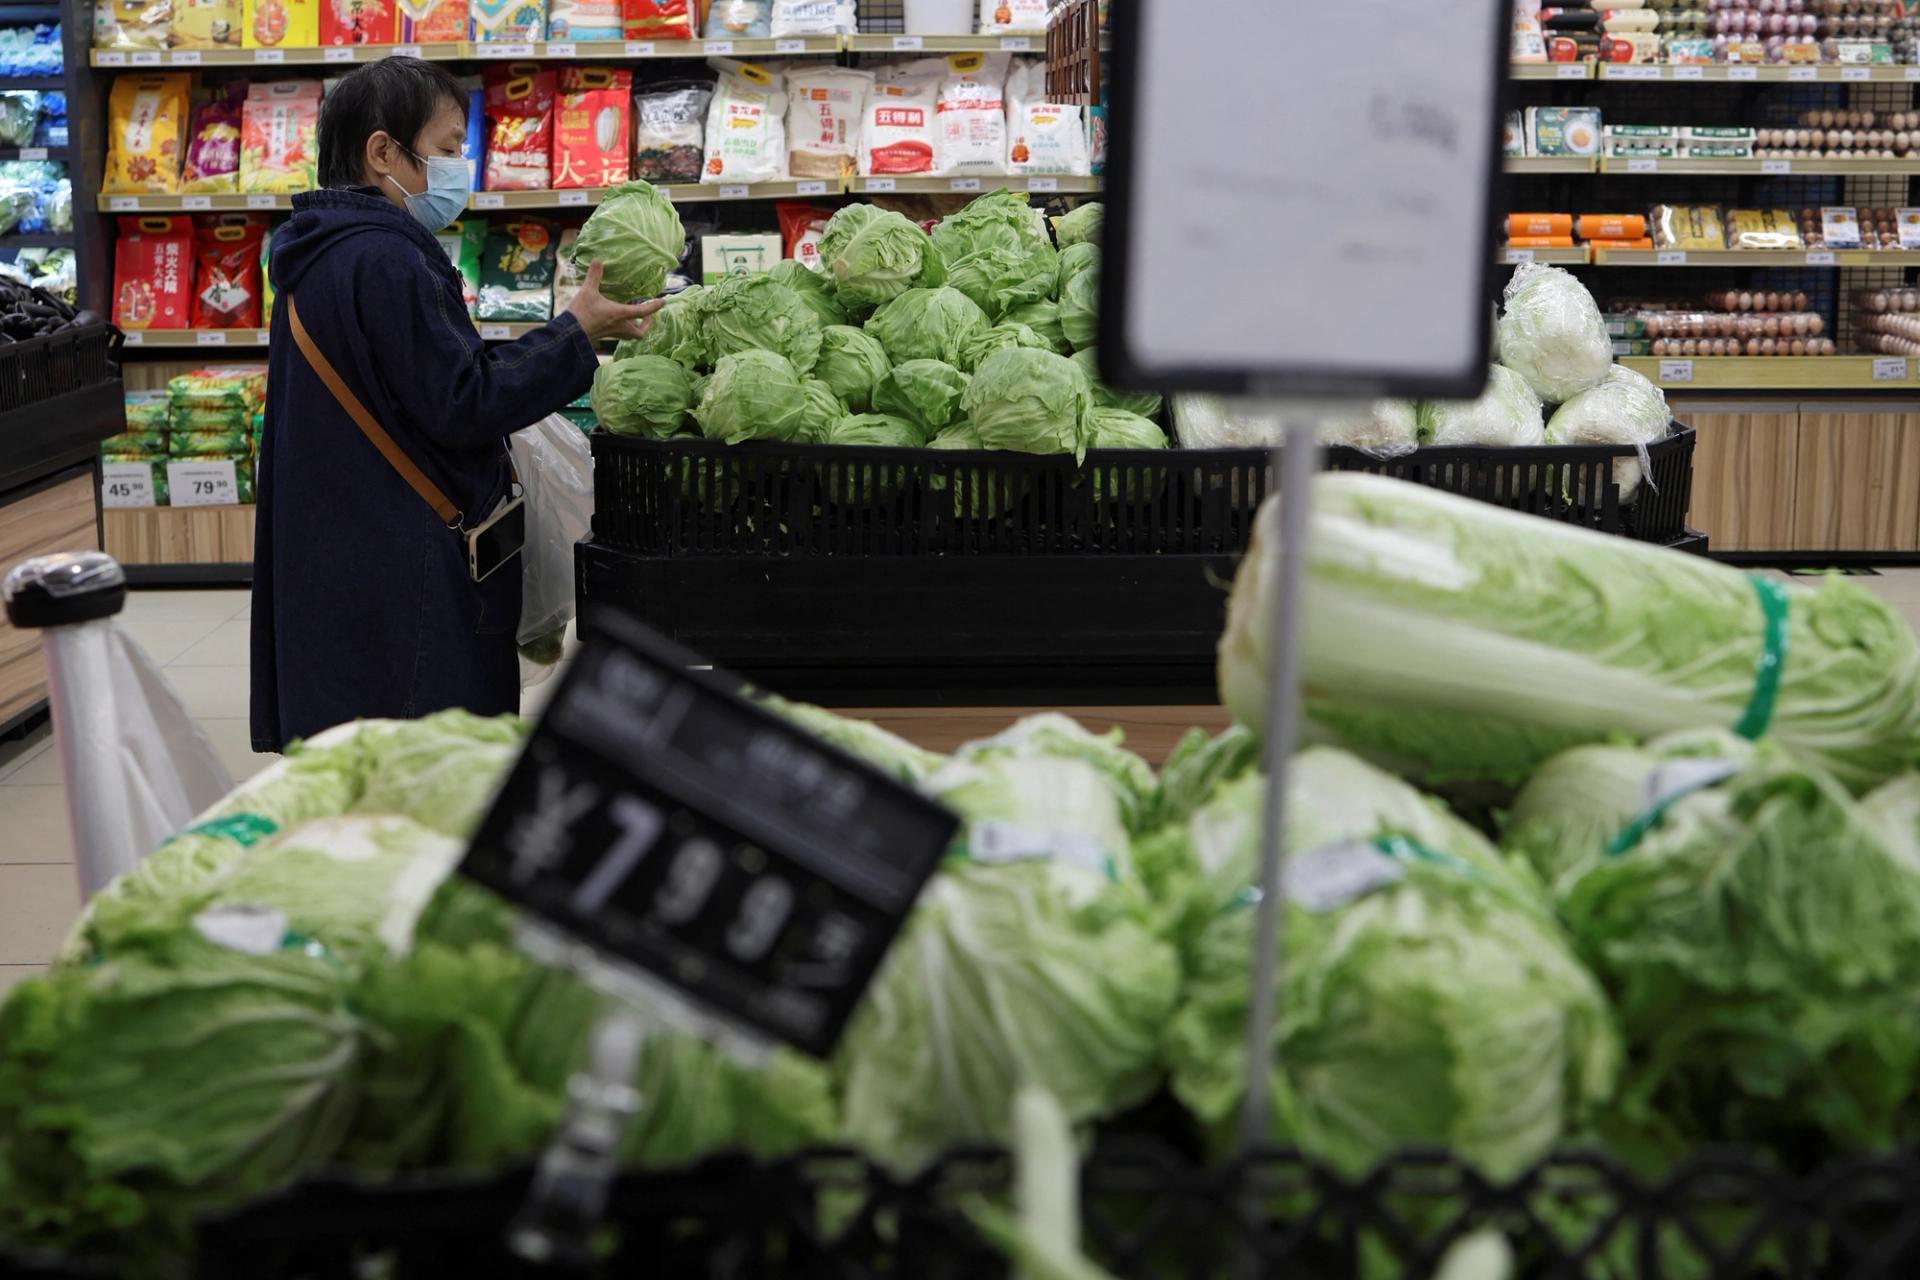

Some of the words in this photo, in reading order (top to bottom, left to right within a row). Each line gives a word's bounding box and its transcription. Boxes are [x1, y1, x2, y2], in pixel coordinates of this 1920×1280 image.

[819, 103, 834, 143] 五得利
[879, 110, 921, 125] 五得利
[154, 243, 164, 289] 五常大米
[109, 483, 130, 496] 45
[191, 480, 214, 494] 79
